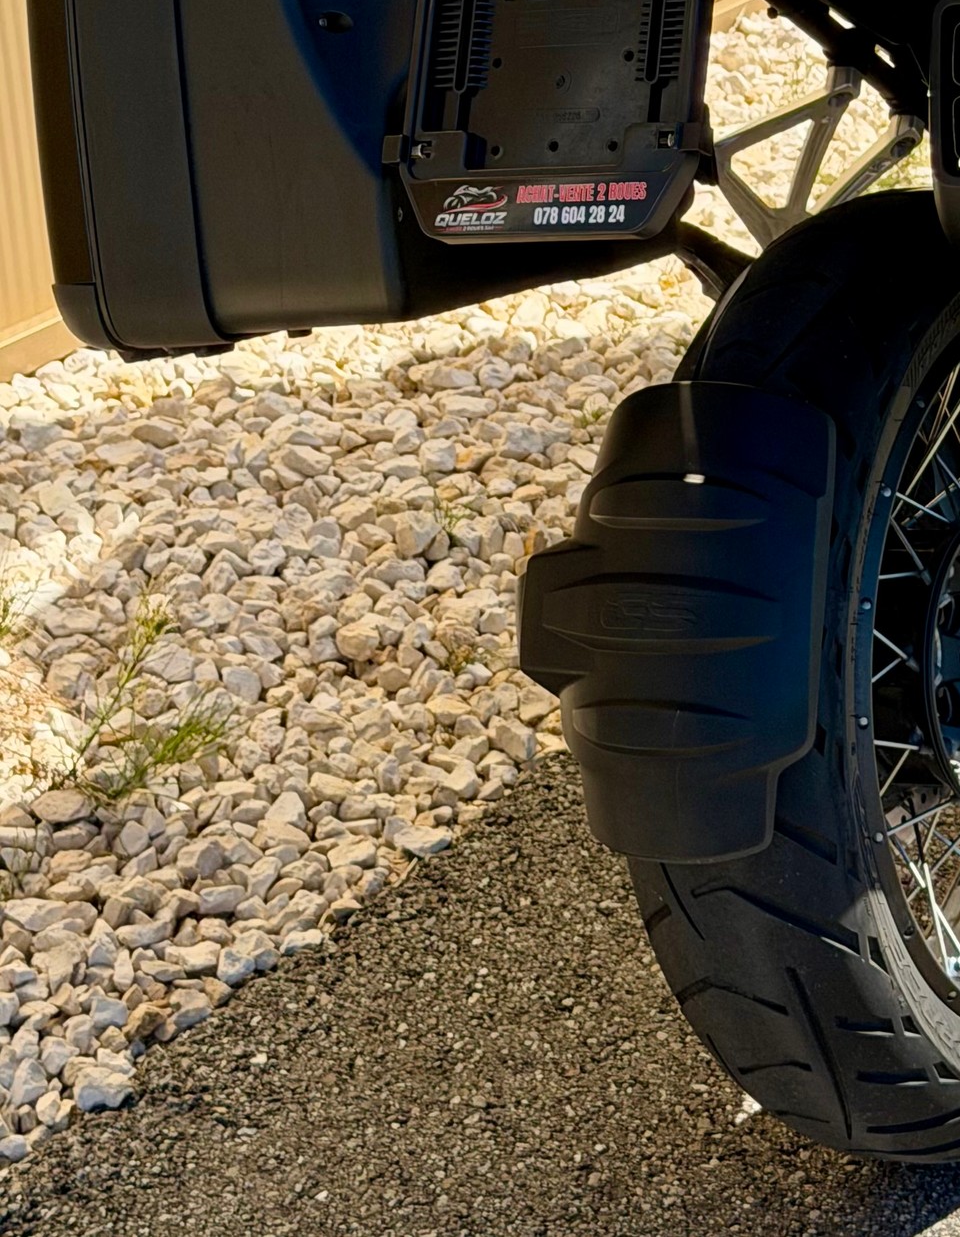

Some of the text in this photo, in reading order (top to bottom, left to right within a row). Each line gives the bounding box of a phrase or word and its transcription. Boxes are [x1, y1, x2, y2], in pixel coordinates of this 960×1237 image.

[516, 181, 647, 203] ACHAT-VENTE 2 ROUES
[434, 211, 508, 227] QUELOZ
[533, 204, 626, 225] 078 604 28 24
